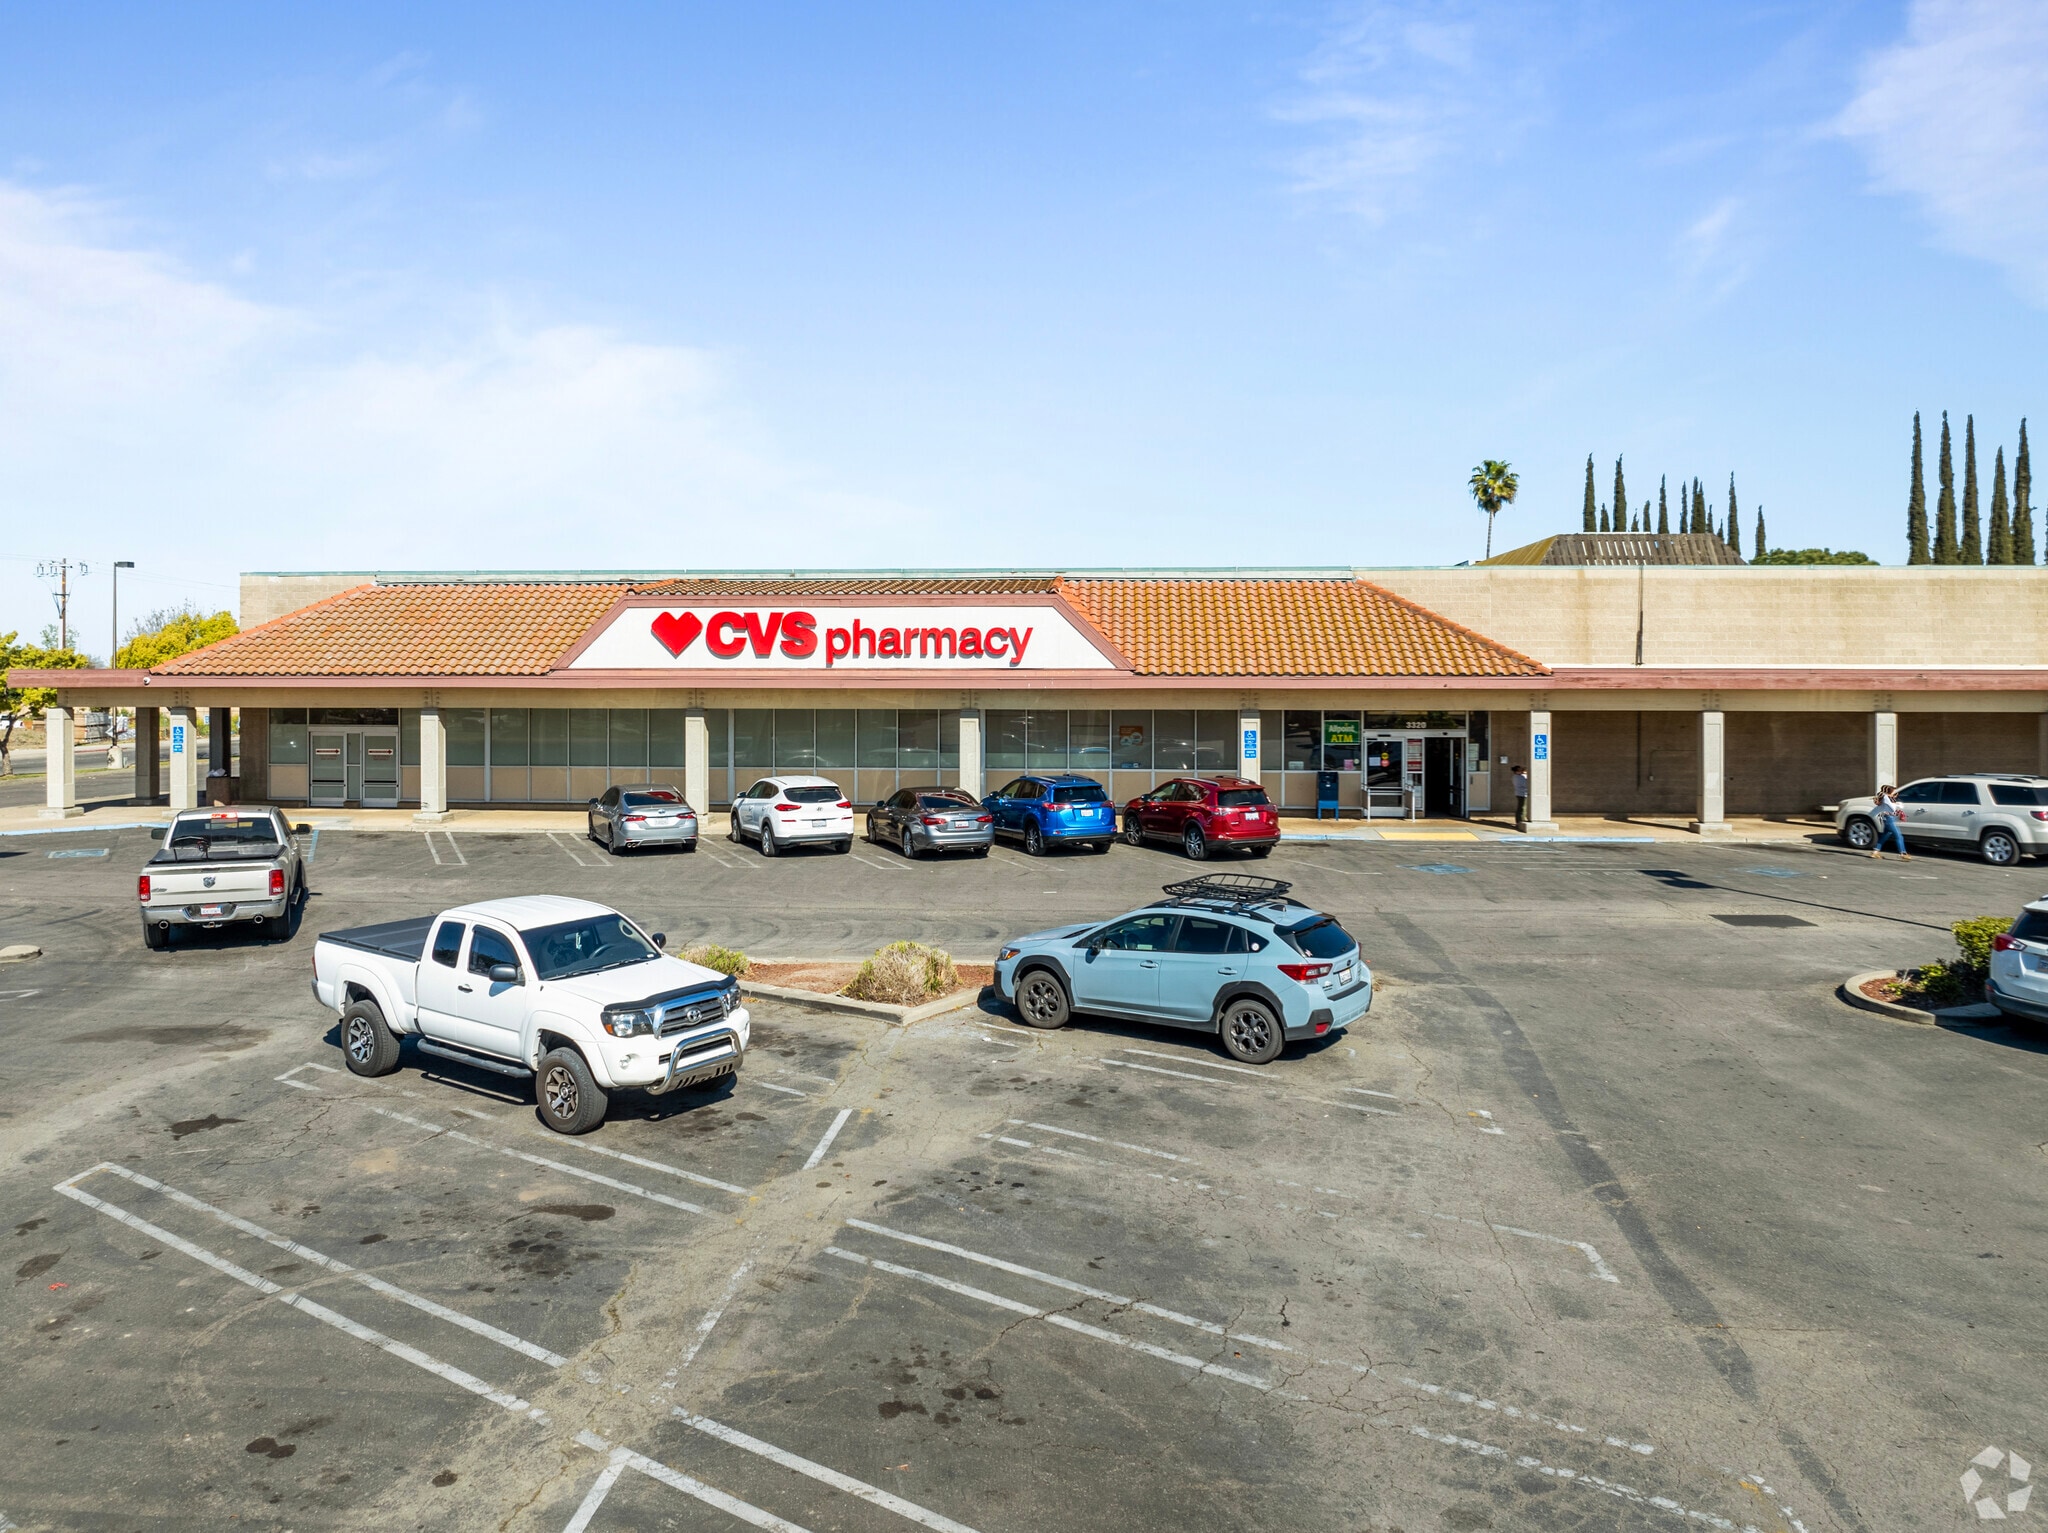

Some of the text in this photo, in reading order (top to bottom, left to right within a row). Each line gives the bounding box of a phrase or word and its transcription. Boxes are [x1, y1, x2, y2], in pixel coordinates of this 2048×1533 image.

[705, 611, 1033, 664] CVS pharmacy
[1405, 721, 1427, 729] 3320
[1331, 734, 1353, 743] ATM
